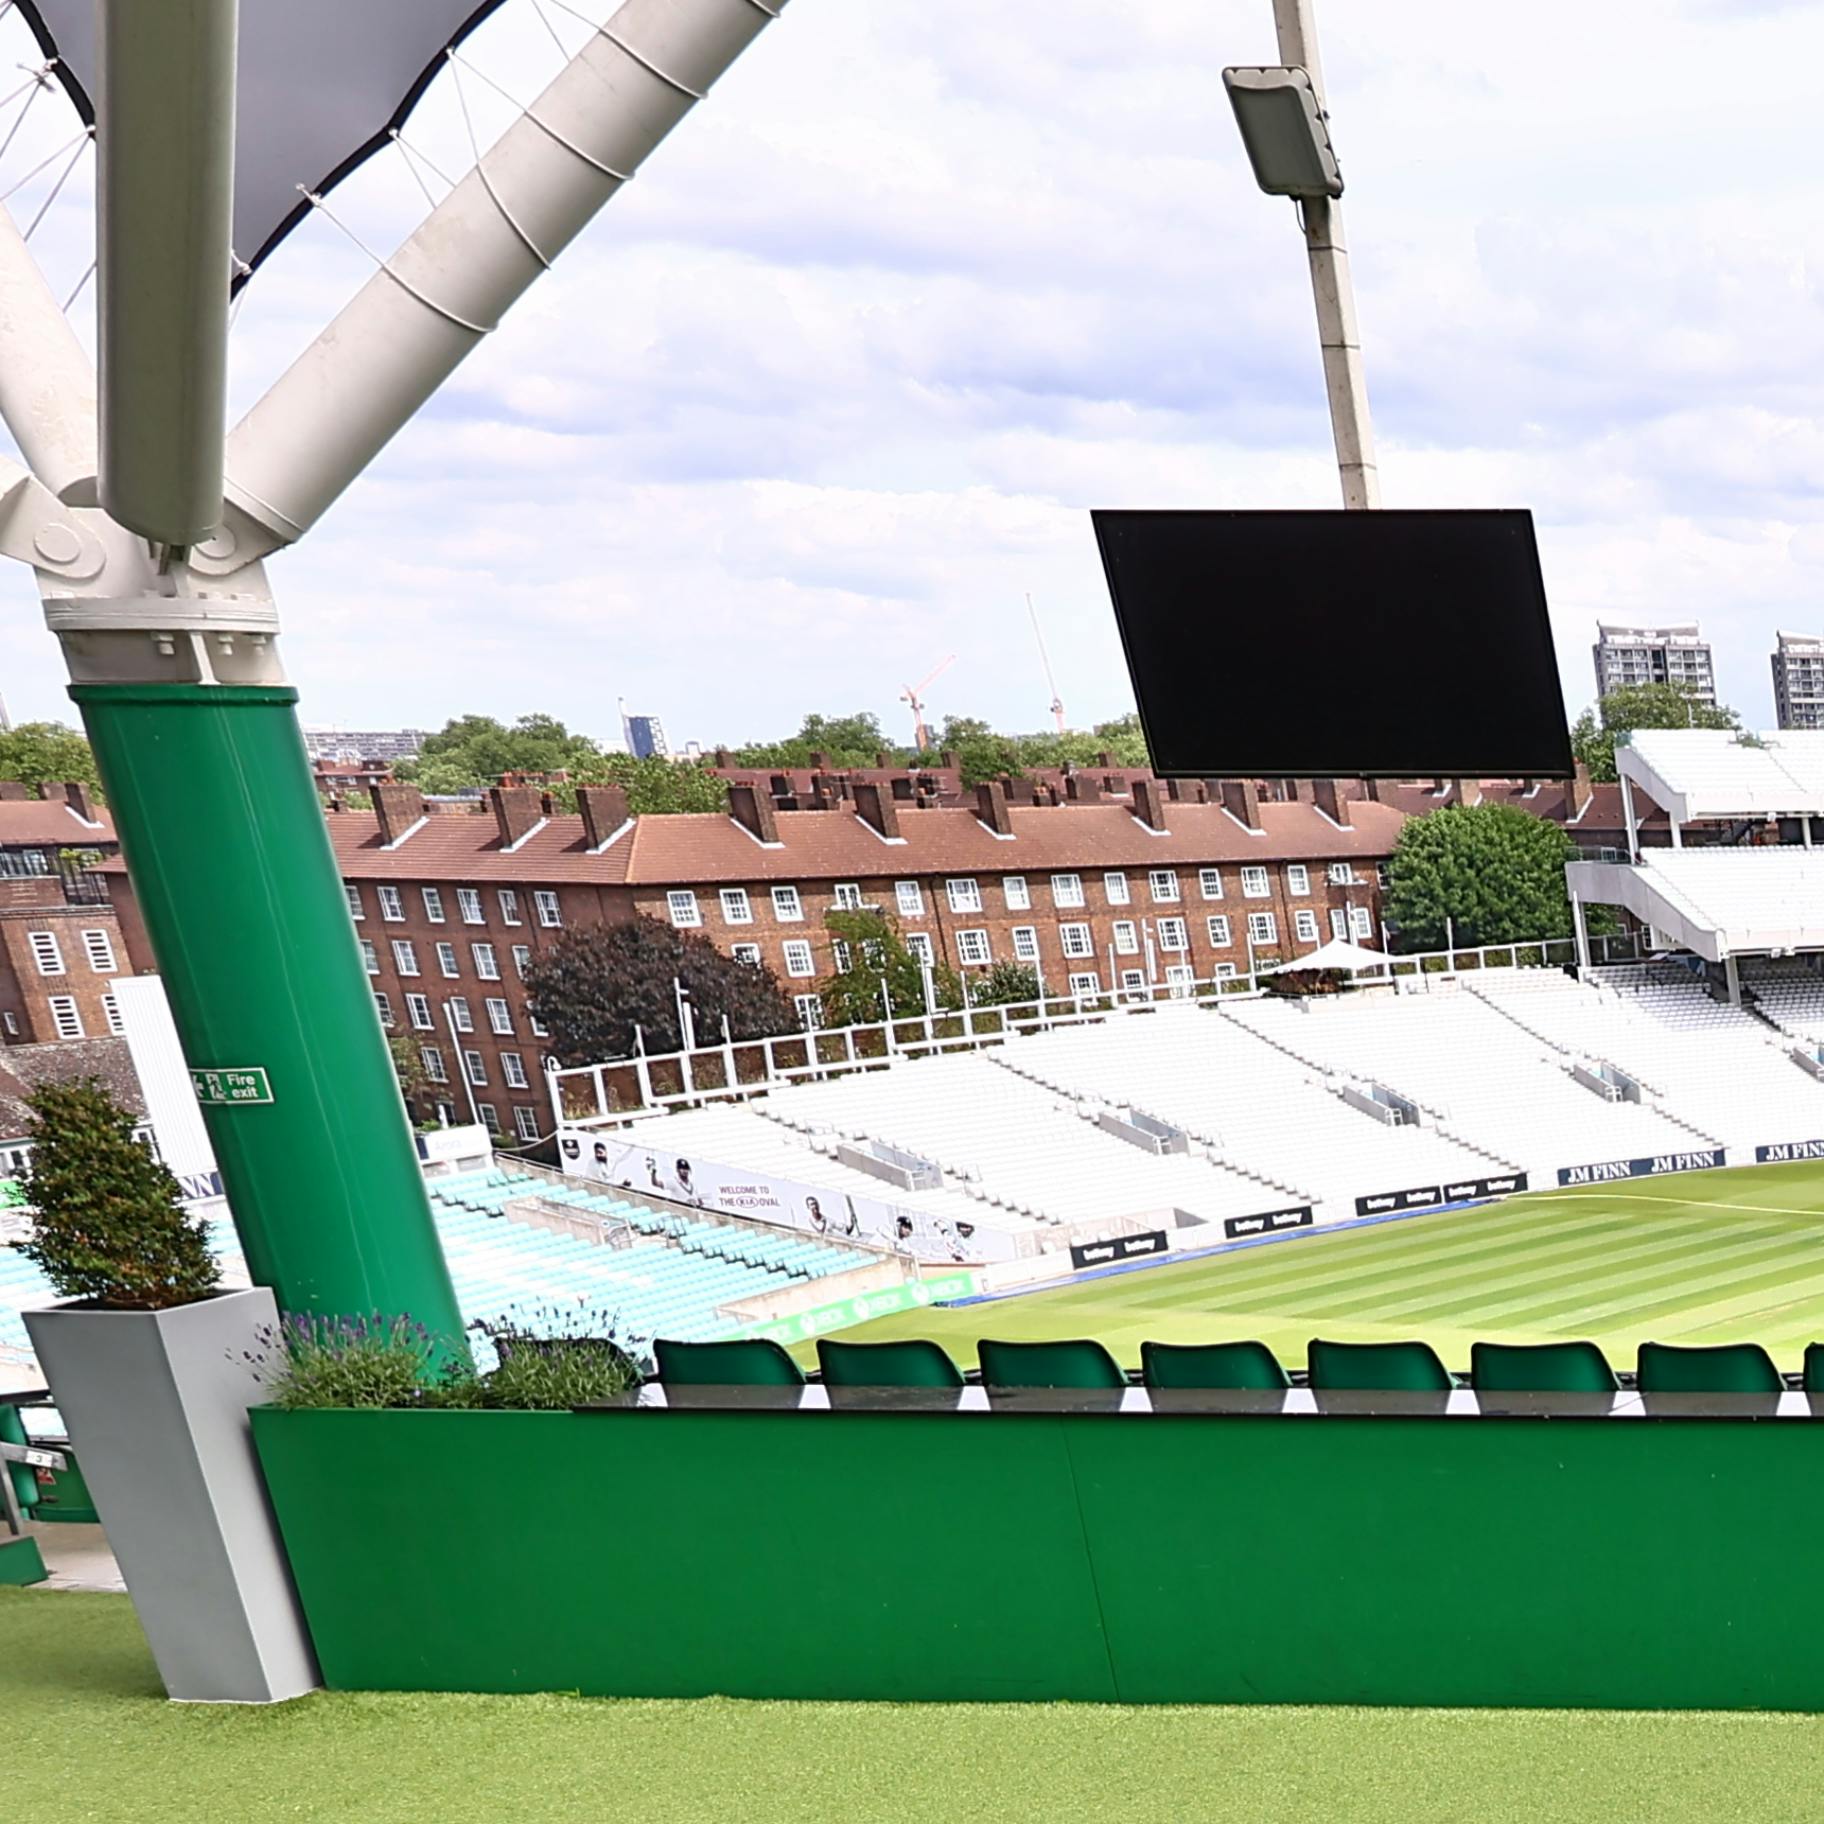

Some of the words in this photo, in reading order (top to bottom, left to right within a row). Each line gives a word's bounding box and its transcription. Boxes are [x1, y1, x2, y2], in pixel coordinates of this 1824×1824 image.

[226, 1073, 255, 1086] Fire
[231, 1086, 259, 1099] exit
[1766, 1146, 1788, 1161] JM
[1651, 1156, 1673, 1173] JM
[1675, 1152, 1714, 1170] FINN
[1568, 1168, 1590, 1183] JM
[1592, 1161, 1632, 1181] FINN
[719, 1185, 757, 1195] WELCOME
[760, 1185, 770, 1195] TO
[719, 1197, 736, 1207] THE
[760, 1197, 780, 1207] OVAL
